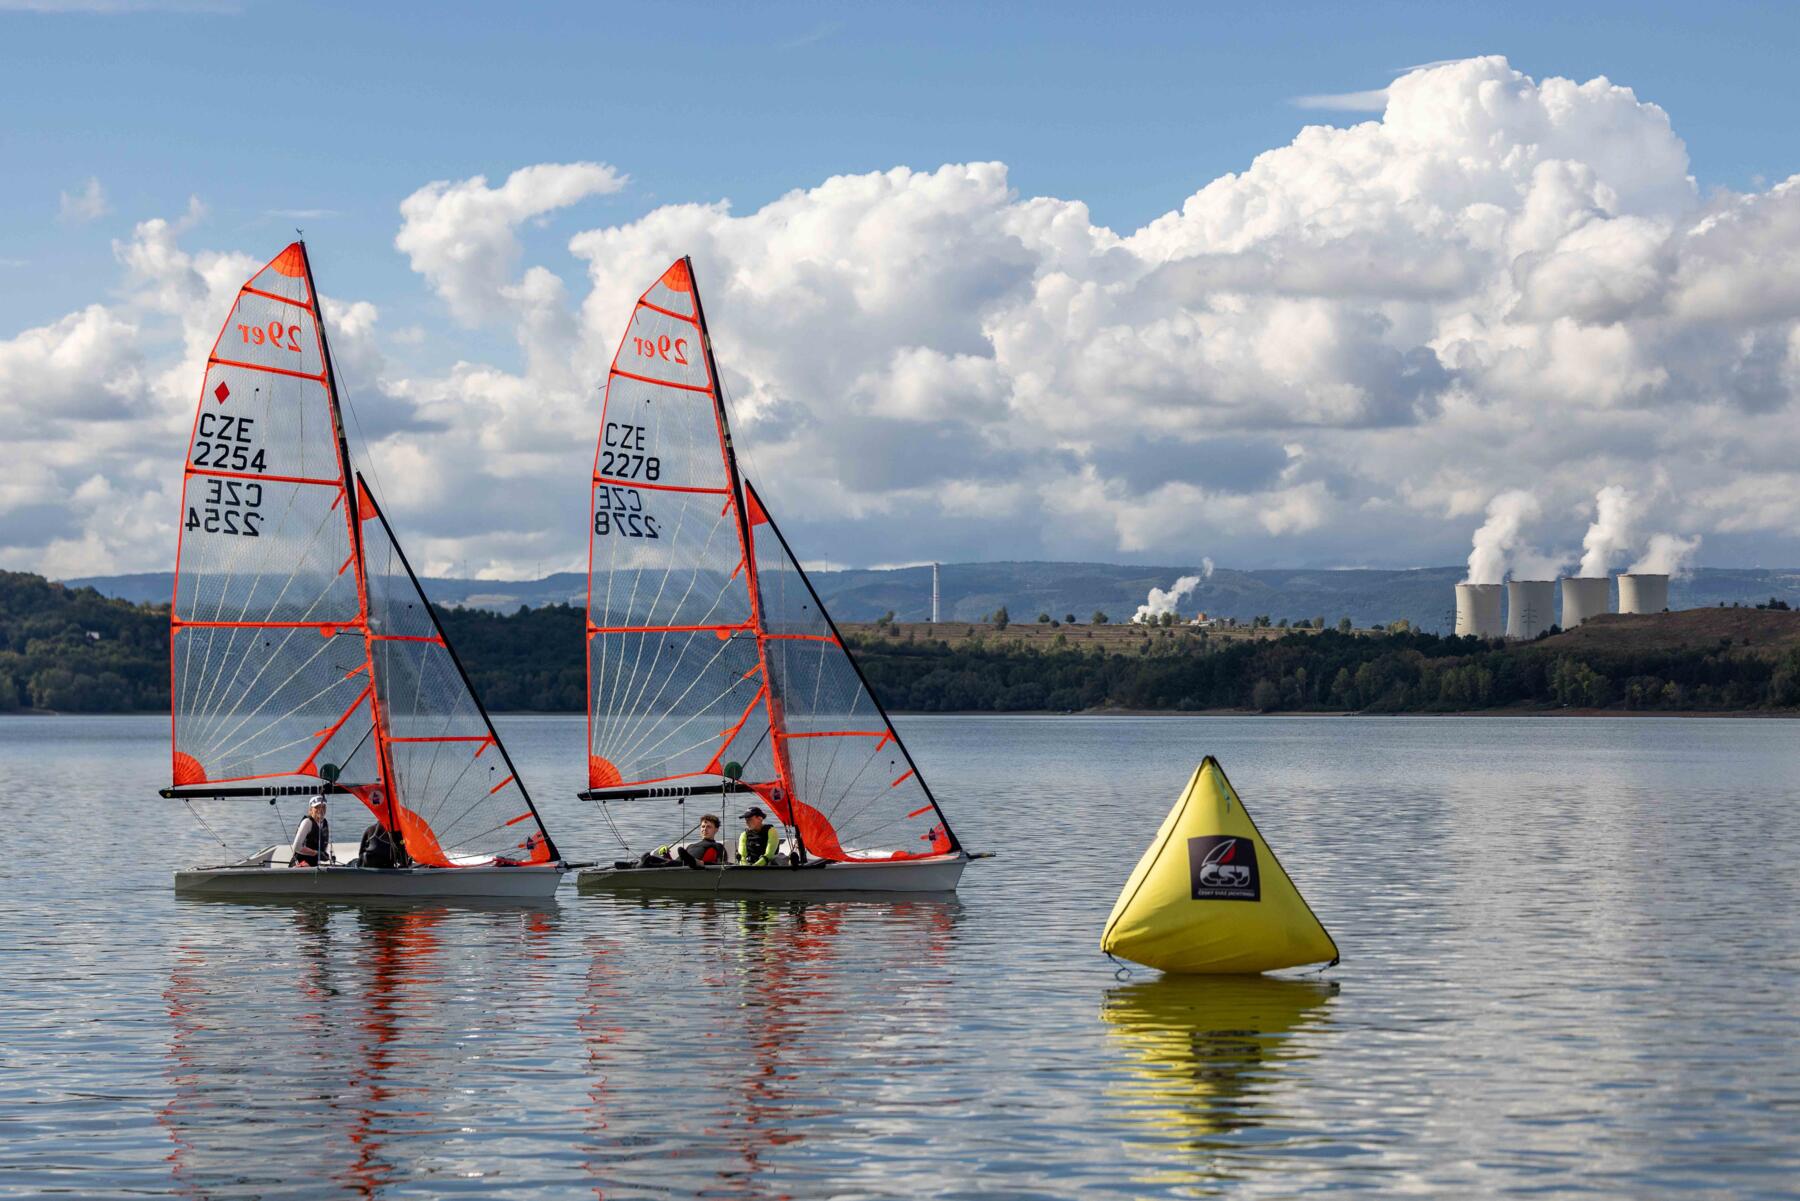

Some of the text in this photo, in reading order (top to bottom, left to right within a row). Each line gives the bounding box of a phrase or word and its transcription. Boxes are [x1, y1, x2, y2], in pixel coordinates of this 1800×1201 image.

[199, 412, 254, 443] CZE
[605, 422, 645, 451] CZE
[193, 441, 267, 473] 2254
[601, 451, 660, 481] 2278
